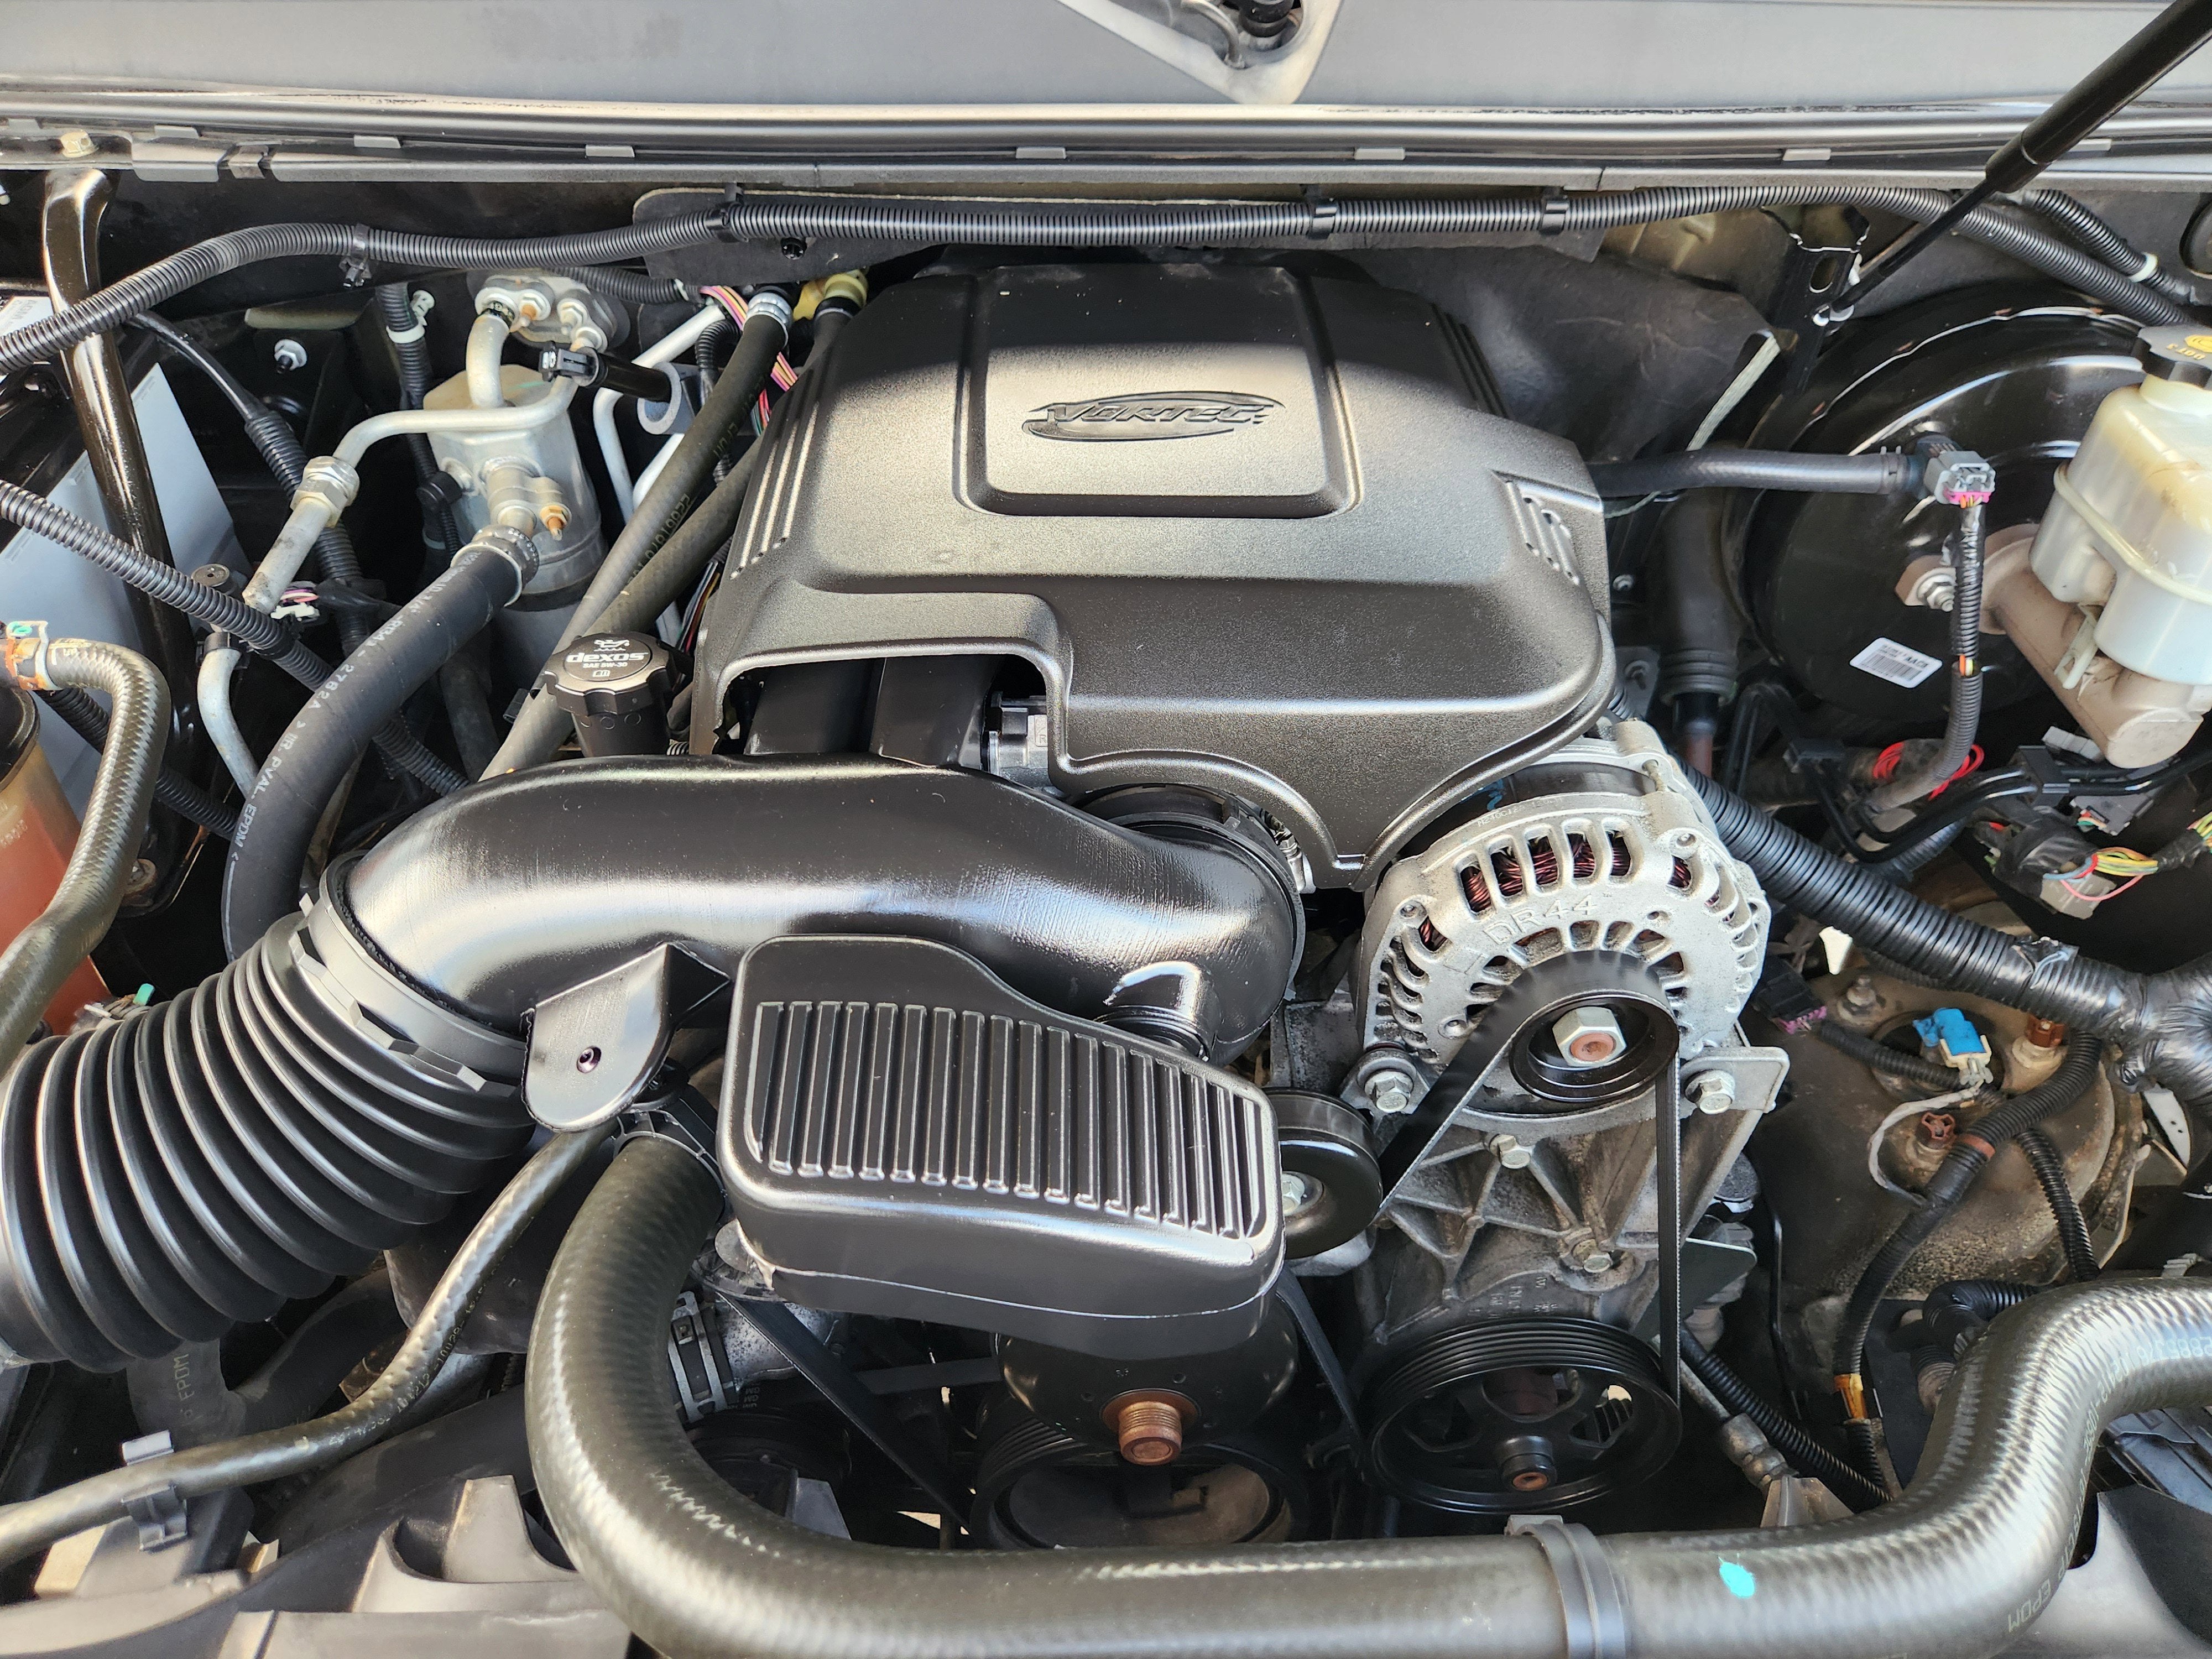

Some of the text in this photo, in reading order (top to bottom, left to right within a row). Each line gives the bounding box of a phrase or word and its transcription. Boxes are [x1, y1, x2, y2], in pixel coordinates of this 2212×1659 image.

[1047, 404, 1264, 424] VORTEC
[566, 653, 645, 662] dexos
[236, 803, 258, 848] EPDM
[173, 1354, 195, 1401] EPDM
[2008, 1578, 2052, 1633] EPDM
